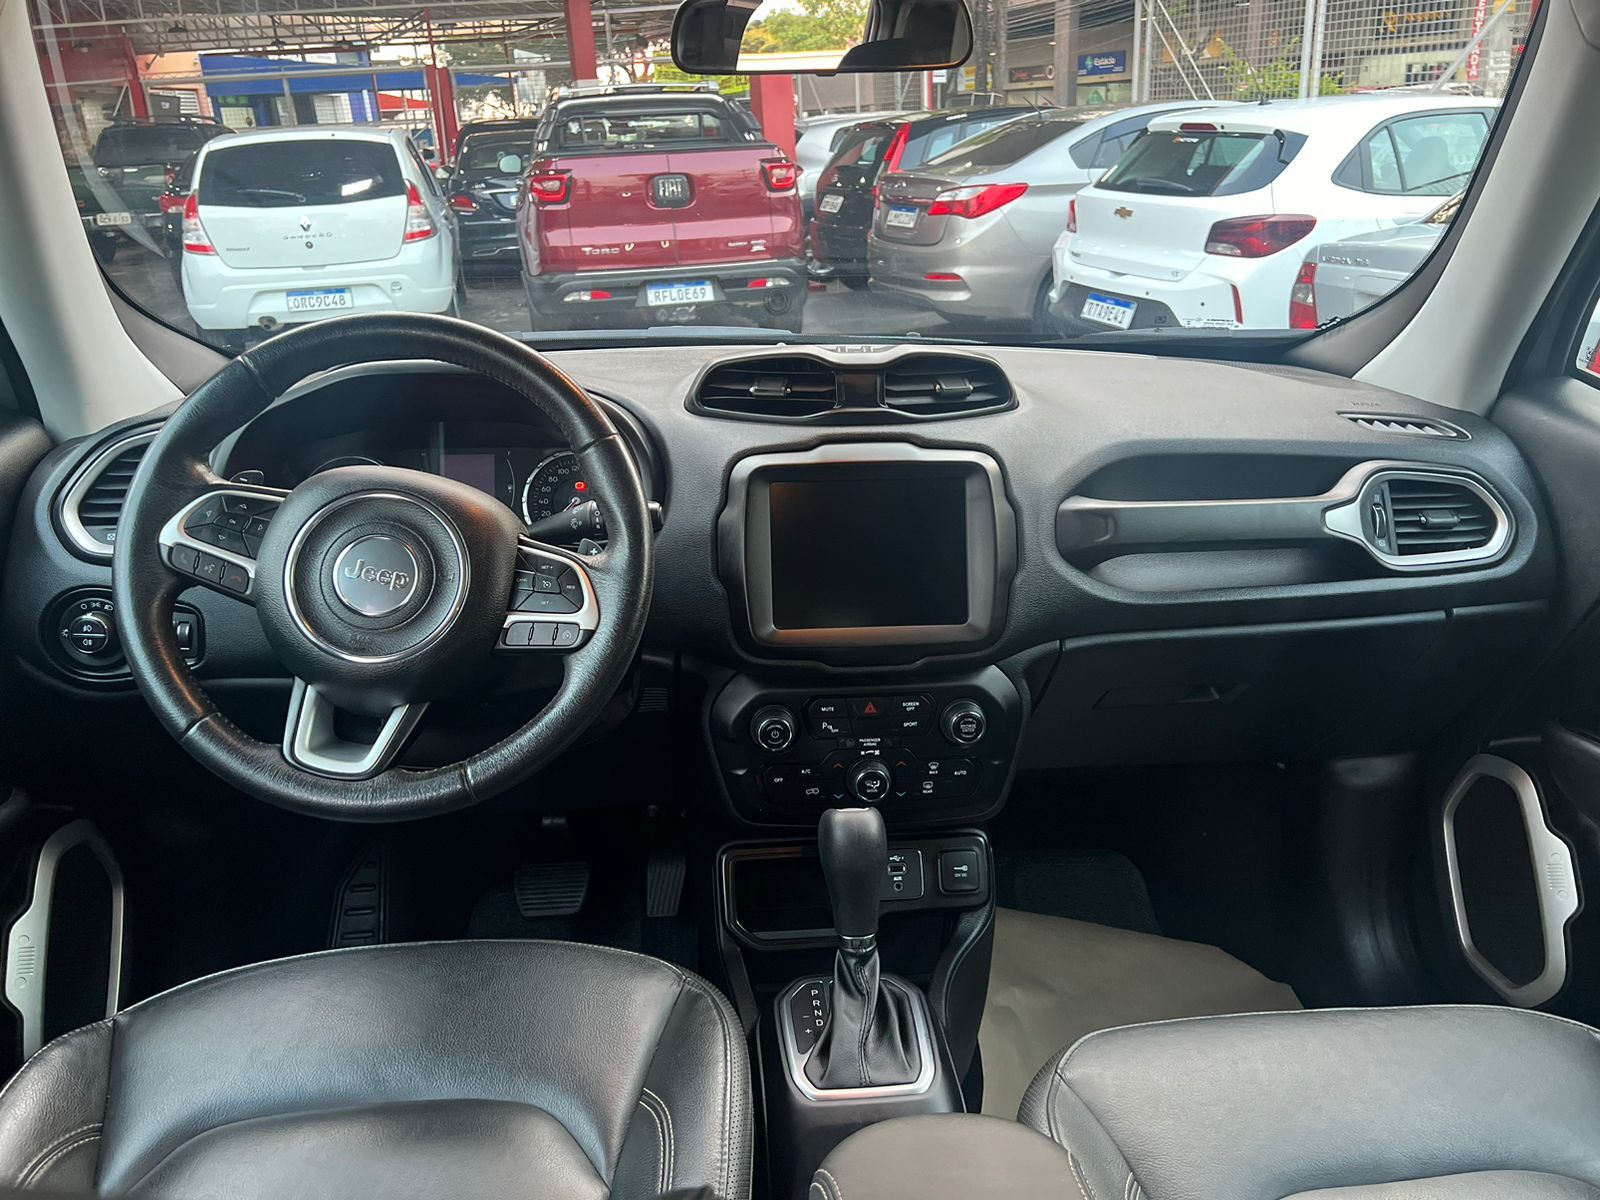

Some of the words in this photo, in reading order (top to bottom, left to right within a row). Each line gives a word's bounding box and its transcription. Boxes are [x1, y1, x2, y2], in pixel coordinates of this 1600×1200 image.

[659, 179, 683, 197] FIAT
[293, 294, 347, 309] ORC9C48
[344, 558, 409, 591] Jeep
